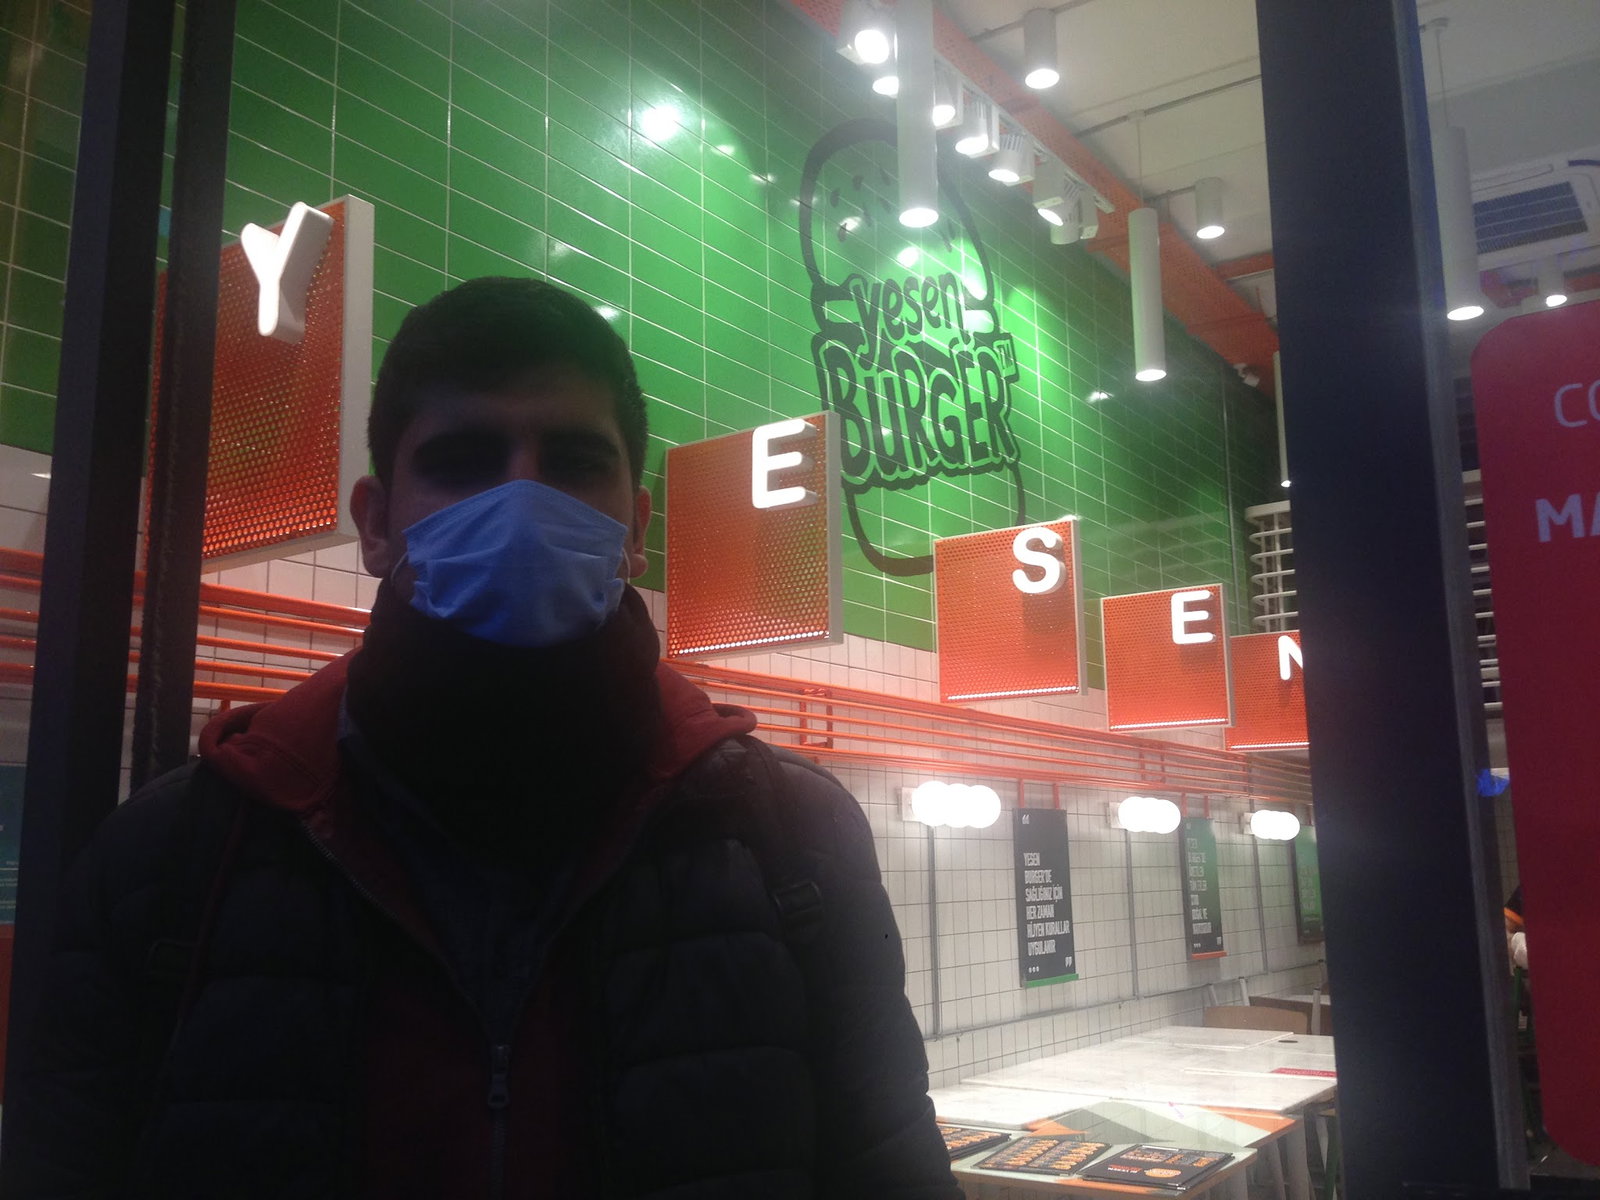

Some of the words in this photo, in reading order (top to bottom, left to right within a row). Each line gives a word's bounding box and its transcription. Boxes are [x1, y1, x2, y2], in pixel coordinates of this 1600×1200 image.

[850, 273, 964, 371] yesen
[241, 202, 318, 337] Y
[752, 419, 812, 508] E
[1012, 527, 1065, 594] S
[1171, 590, 1214, 645] E
[825, 345, 1017, 476] BURGER
